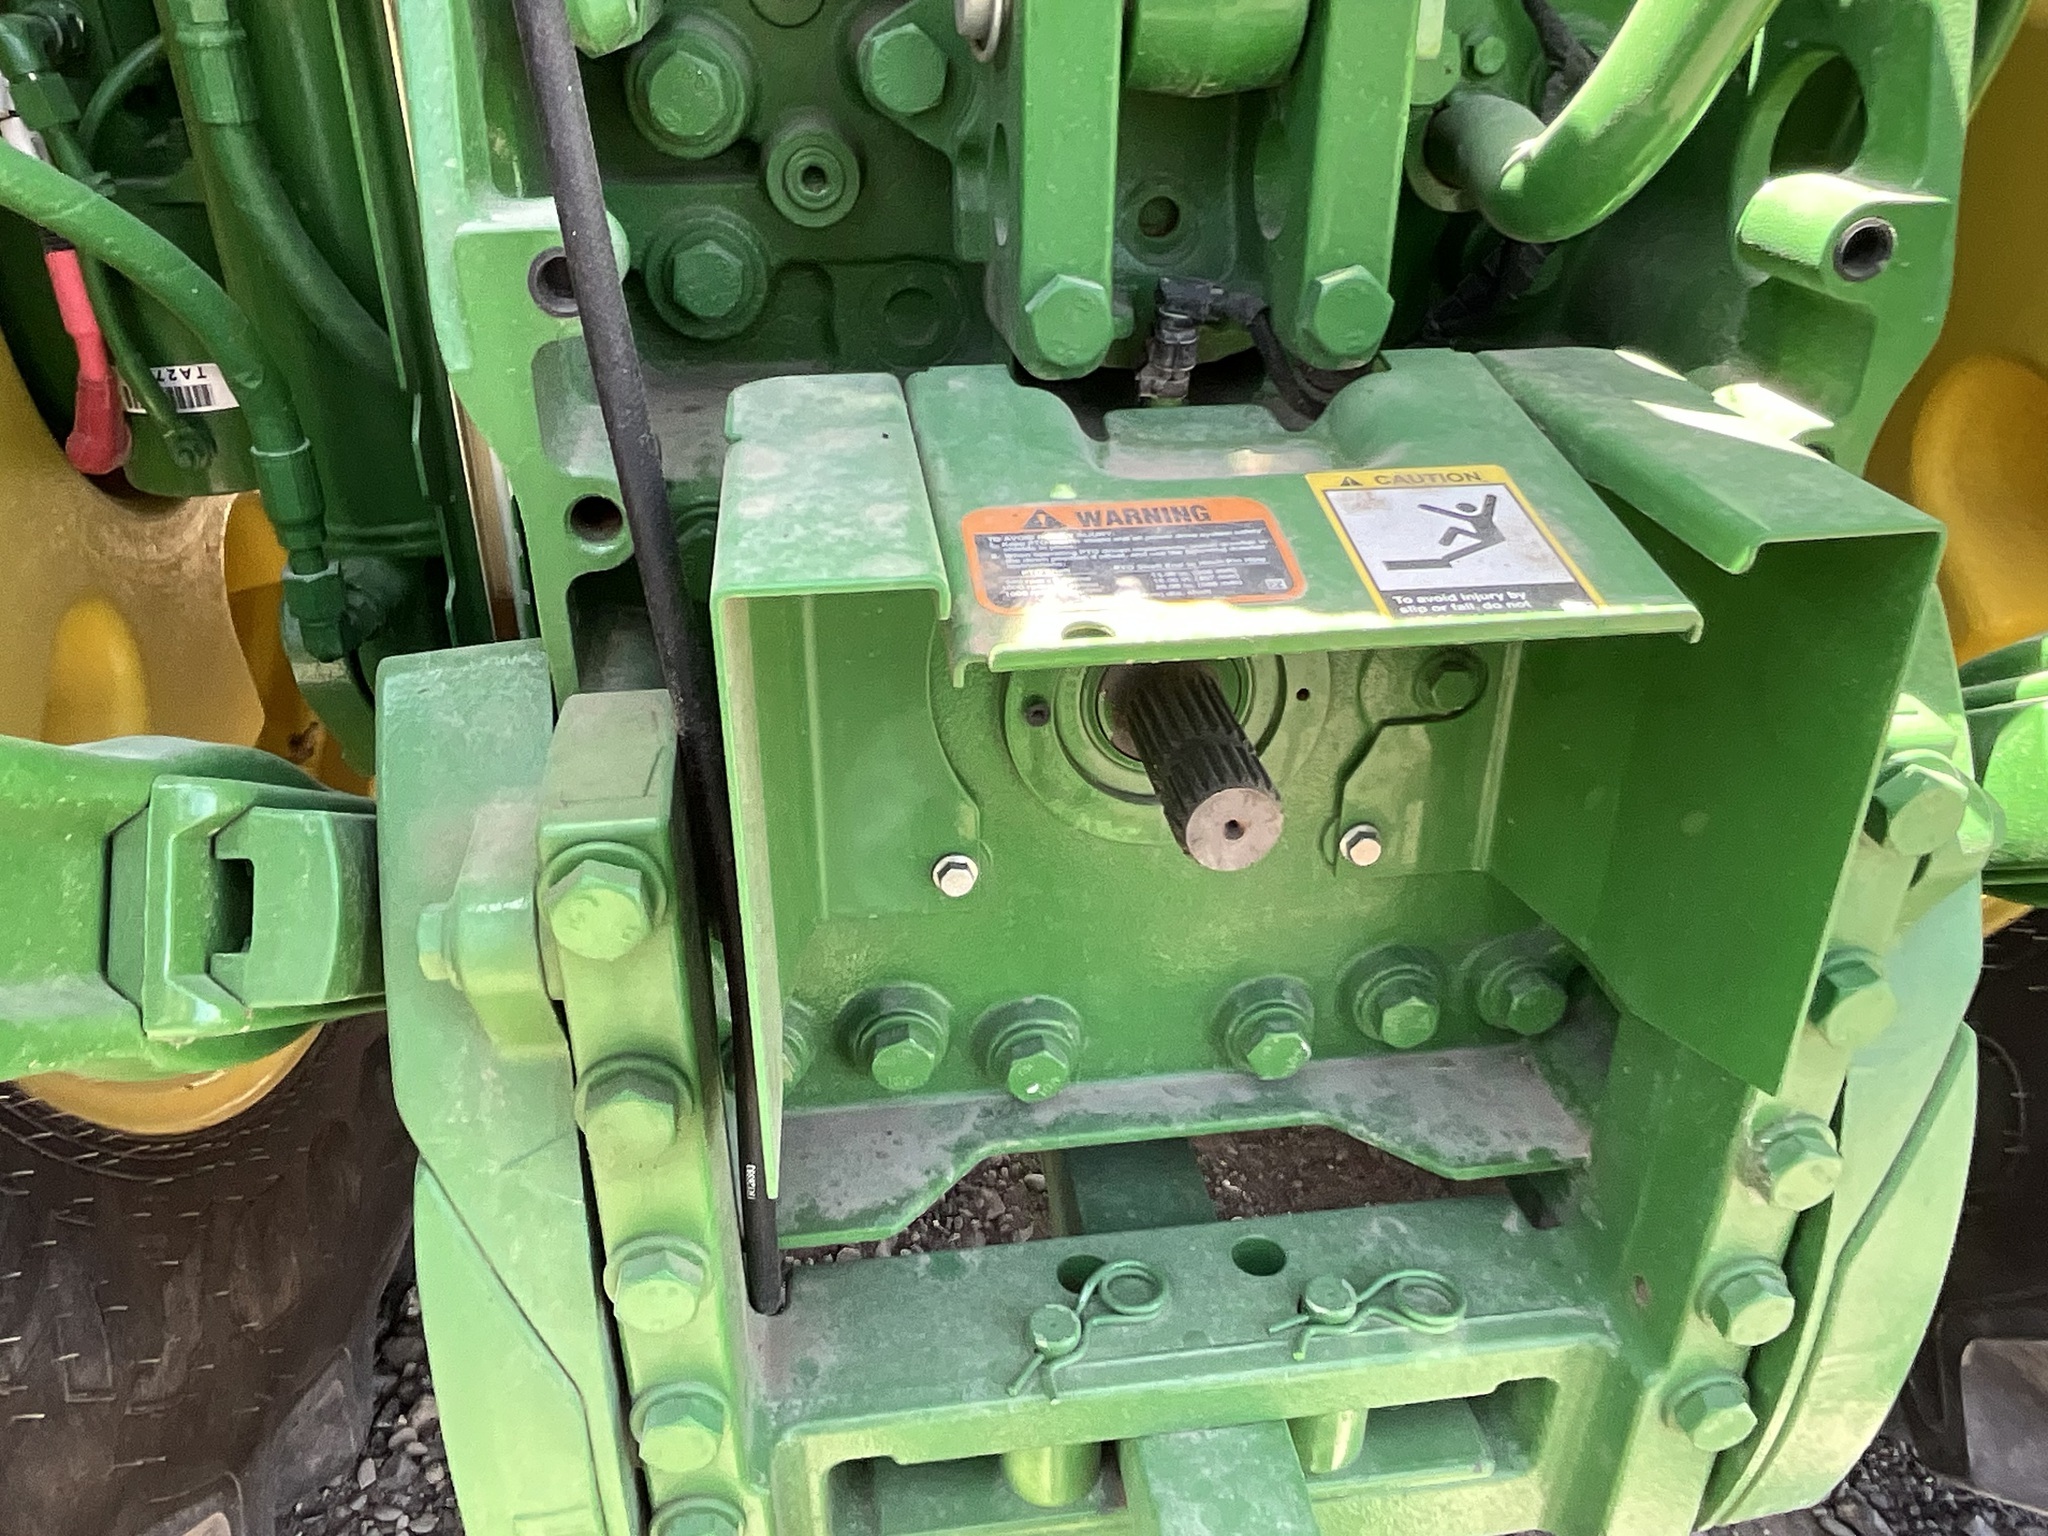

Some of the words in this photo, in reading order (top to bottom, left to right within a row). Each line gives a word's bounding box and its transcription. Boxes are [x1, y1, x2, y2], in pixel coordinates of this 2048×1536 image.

[1374, 472, 1482, 485] CAUTION
[1075, 505, 1212, 527] WARNING
[1392, 595, 1413, 604] To
[1416, 593, 1457, 604] avoid
[1506, 590, 1527, 601] by
[1400, 605, 1428, 614] slip
[1482, 602, 1505, 610] do
[1506, 601, 1533, 609] not
